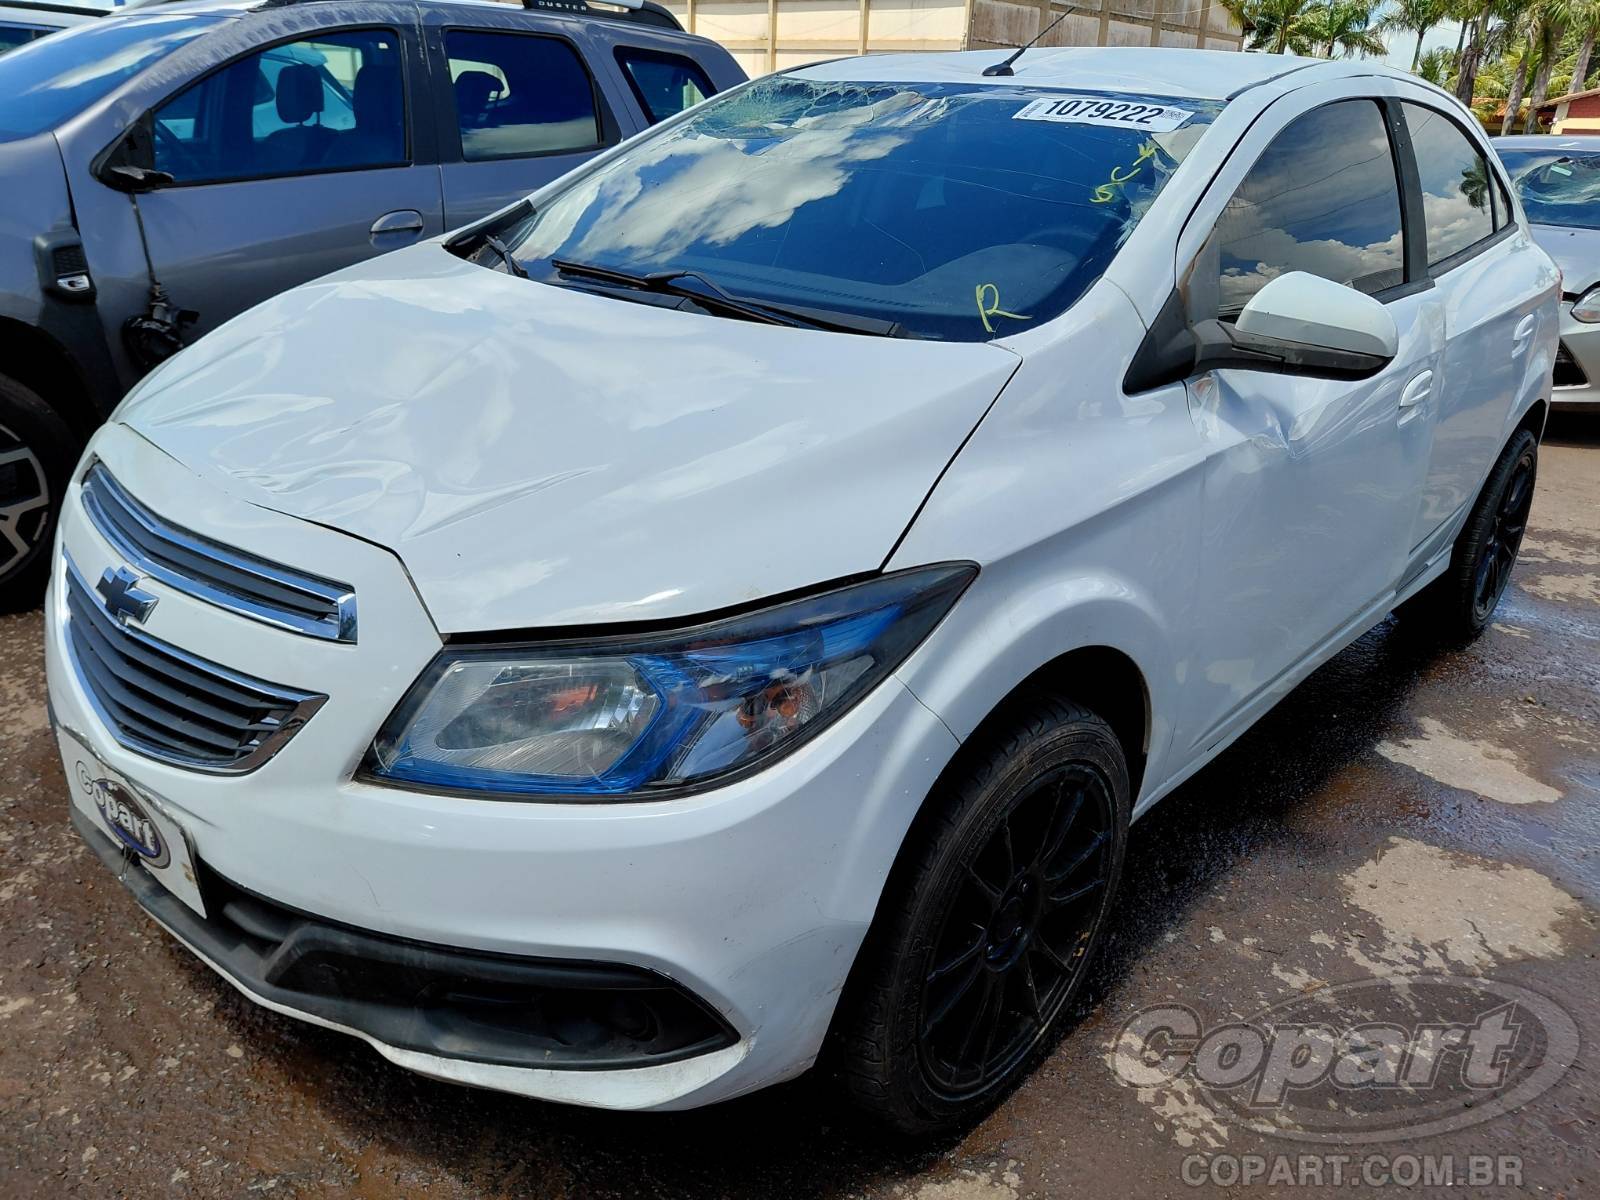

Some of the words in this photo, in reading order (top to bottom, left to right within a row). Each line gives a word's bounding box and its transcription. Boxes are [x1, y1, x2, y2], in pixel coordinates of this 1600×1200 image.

[538, 0, 587, 11] DUSTER
[1044, 99, 1165, 125] 1079222
[975, 283, 1033, 333] R
[75, 760, 157, 853] Copart
